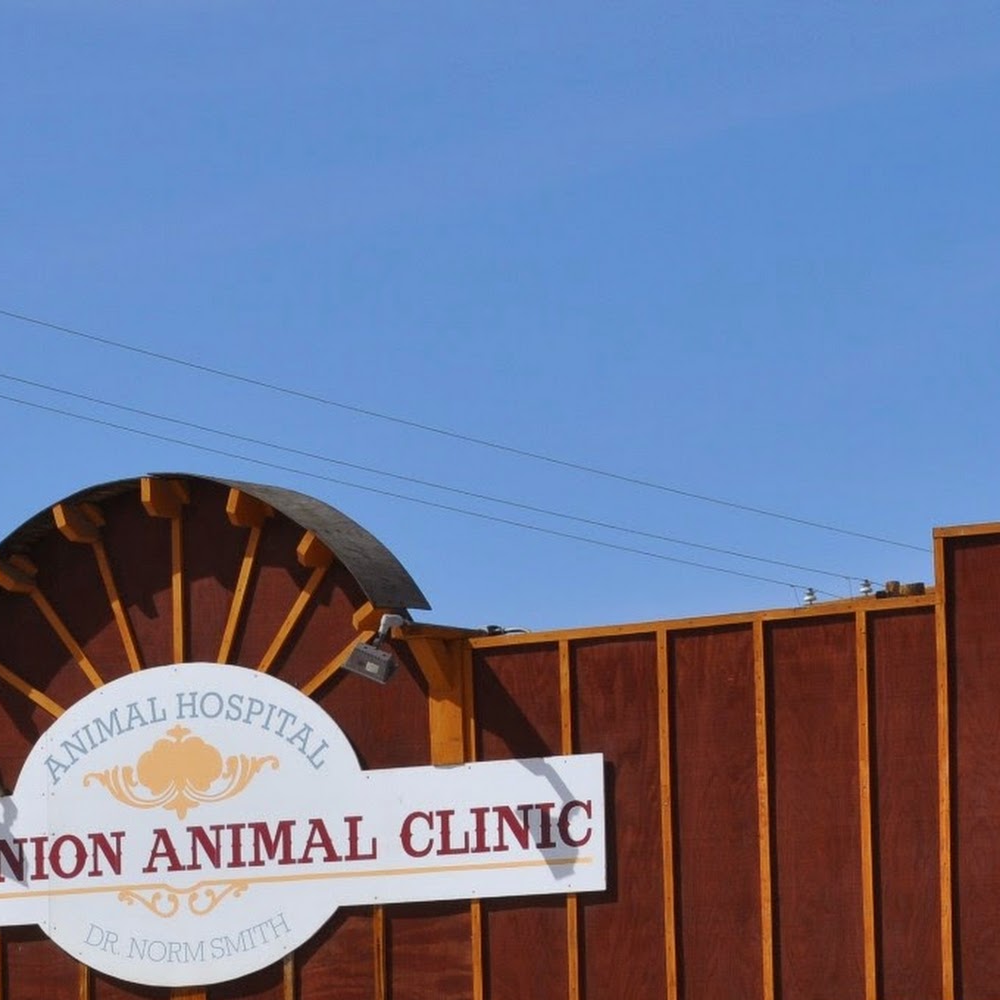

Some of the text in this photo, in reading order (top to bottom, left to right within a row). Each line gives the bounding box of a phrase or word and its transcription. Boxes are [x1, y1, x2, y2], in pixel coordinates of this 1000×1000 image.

[44, 691, 330, 785] ANIMAL HOSPITAL
[142, 816, 377, 874] ANIMAL
[400, 800, 593, 858] CLINIC
[84, 912, 292, 963] DR. NORM SMITH
